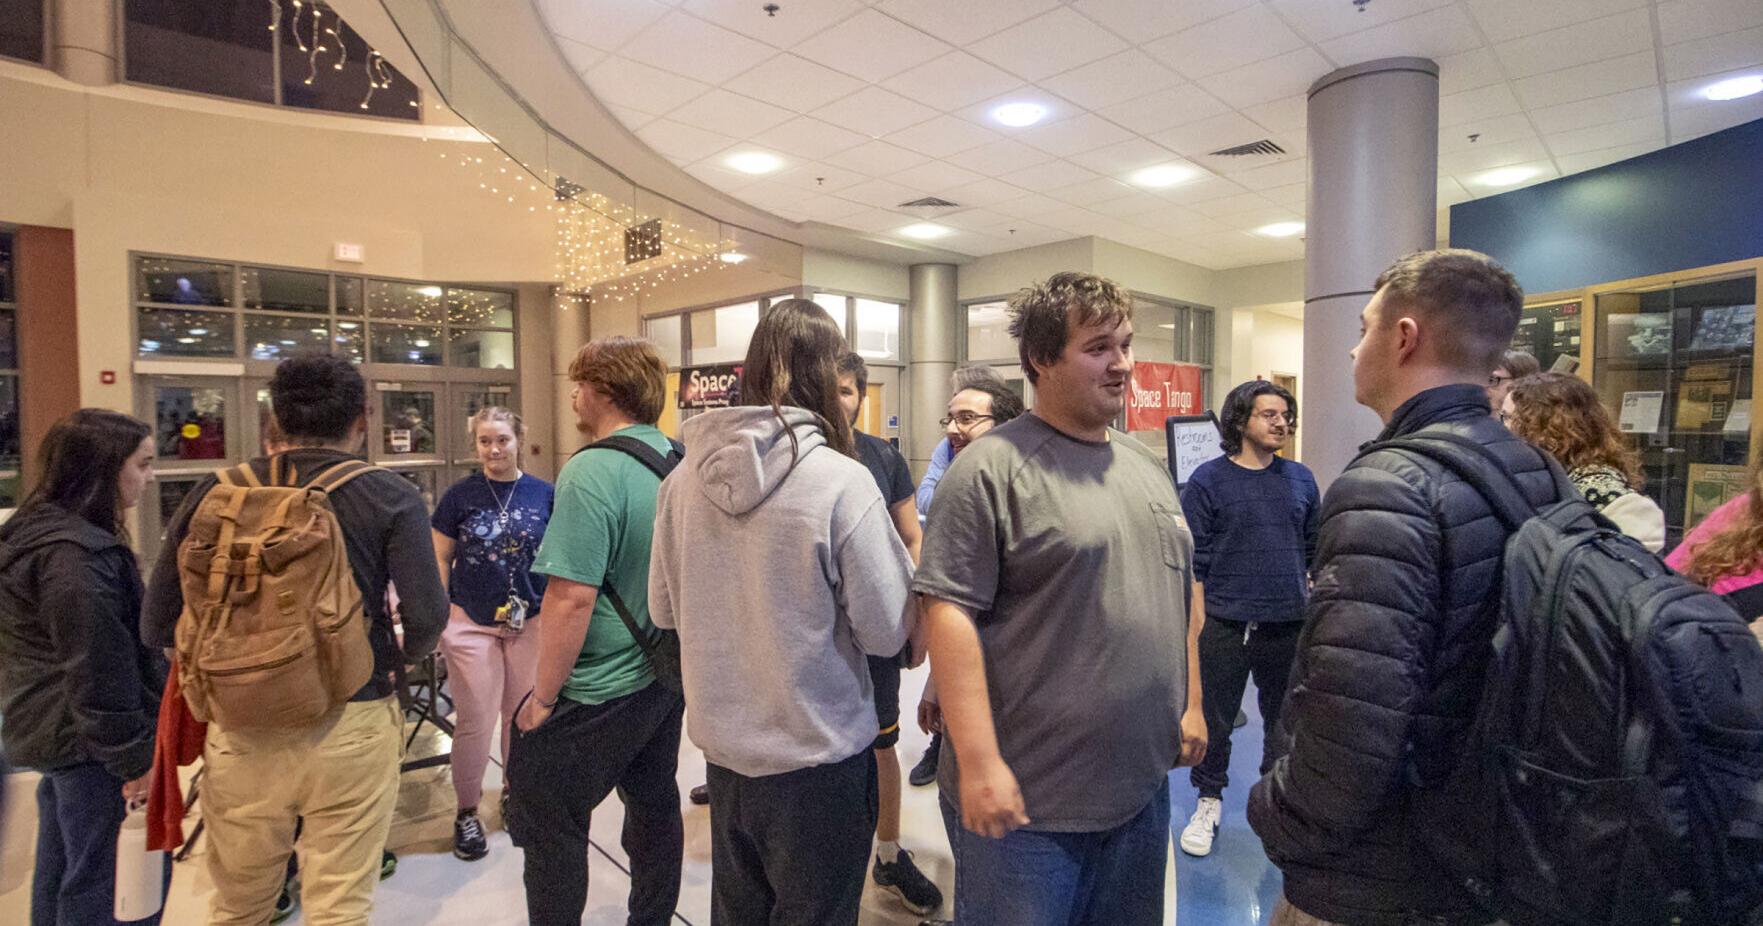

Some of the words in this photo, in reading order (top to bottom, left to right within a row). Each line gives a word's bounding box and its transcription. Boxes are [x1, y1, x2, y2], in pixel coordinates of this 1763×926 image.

[690, 370, 736, 398] Space
[1131, 380, 1161, 413] Space
[1163, 382, 1192, 413] Tango
